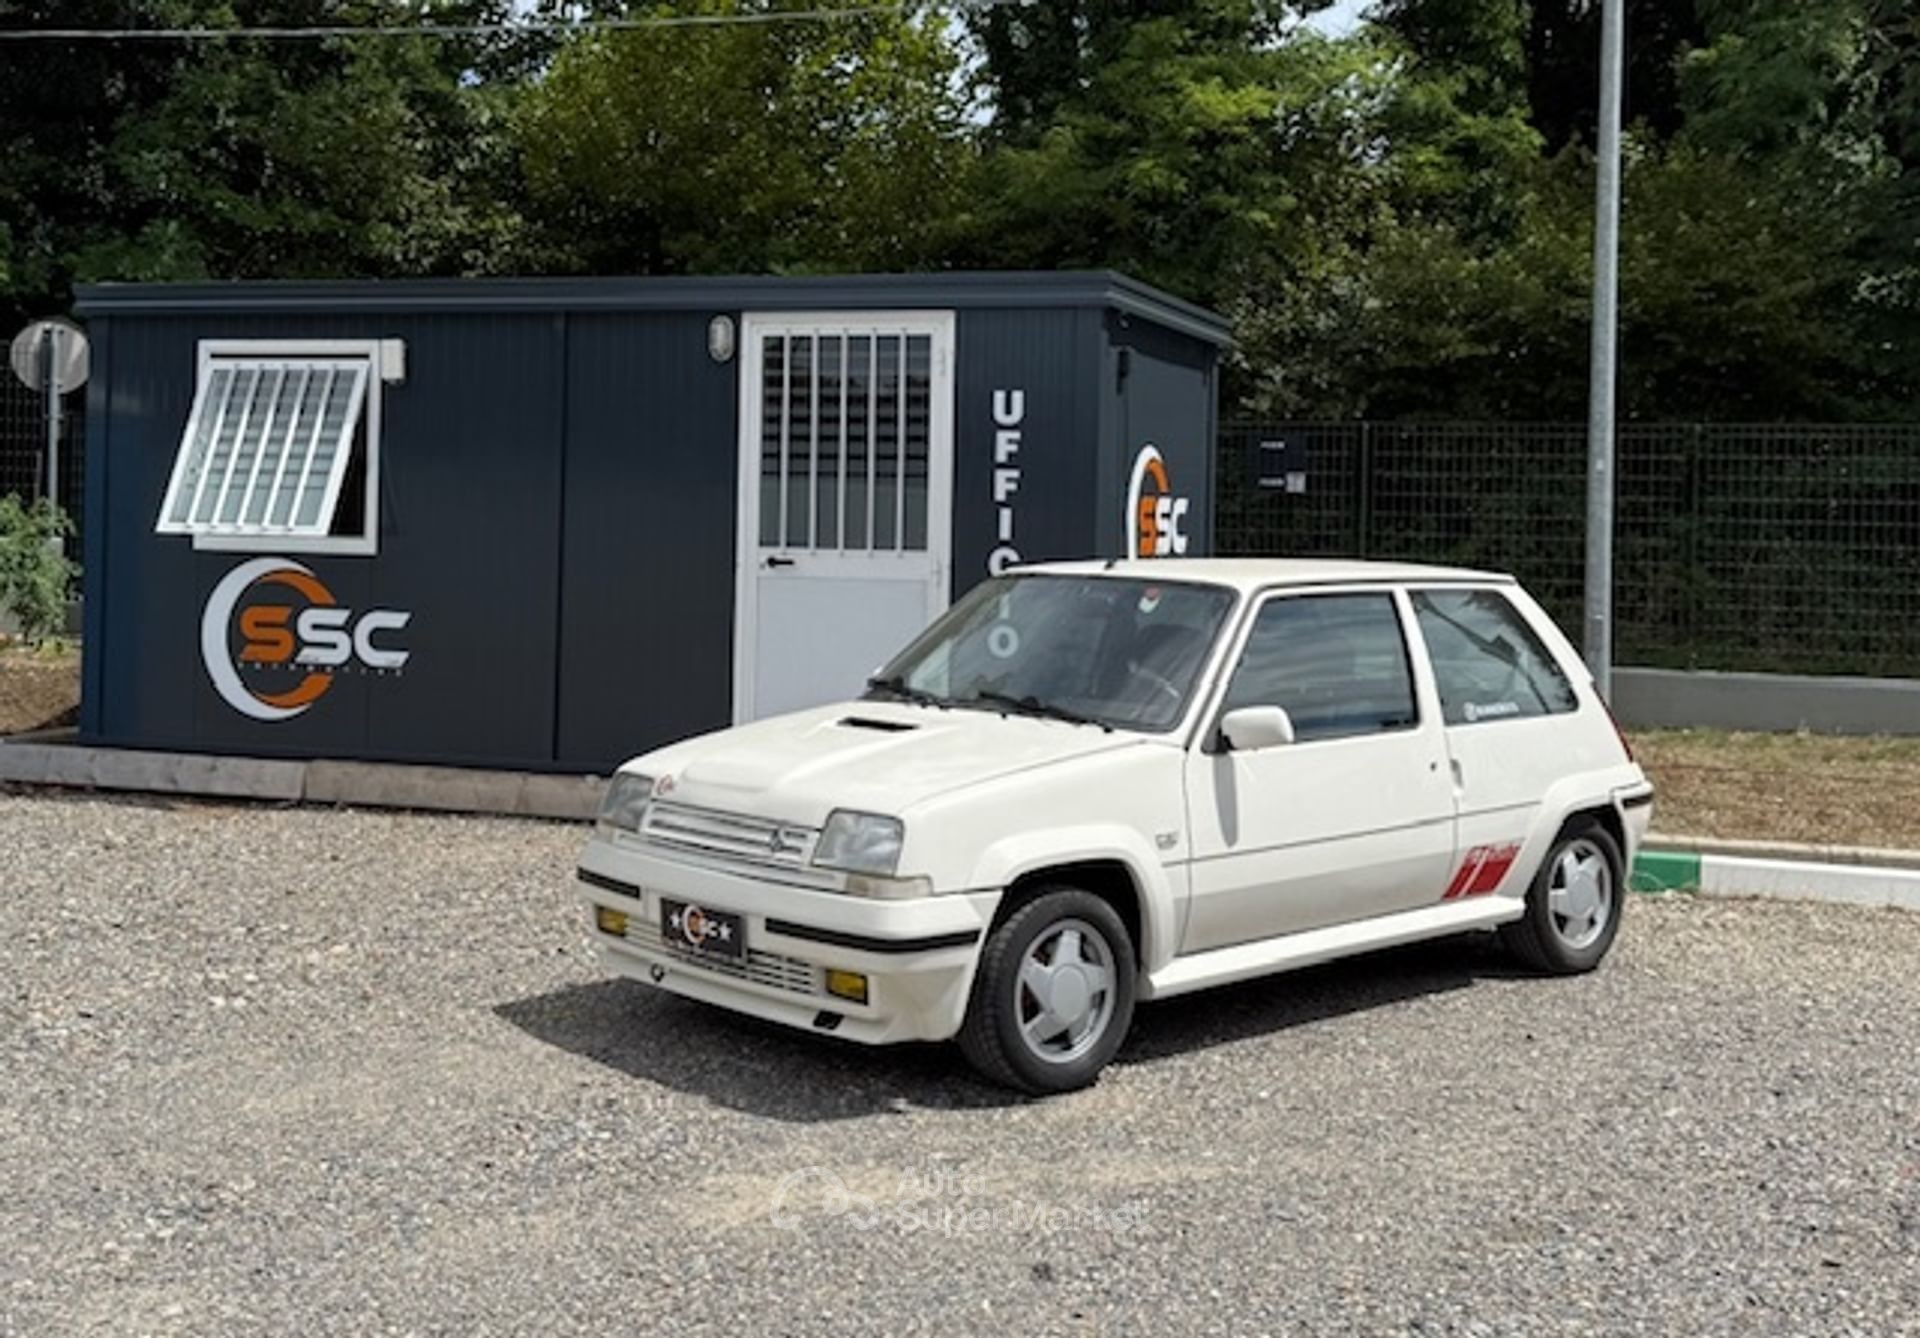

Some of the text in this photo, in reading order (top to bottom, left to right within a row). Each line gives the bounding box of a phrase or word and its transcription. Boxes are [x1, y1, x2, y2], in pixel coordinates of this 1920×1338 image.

[987, 390, 1025, 659] UFFICIO
[1139, 496, 1190, 559] SSC
[239, 606, 412, 668] SSC
